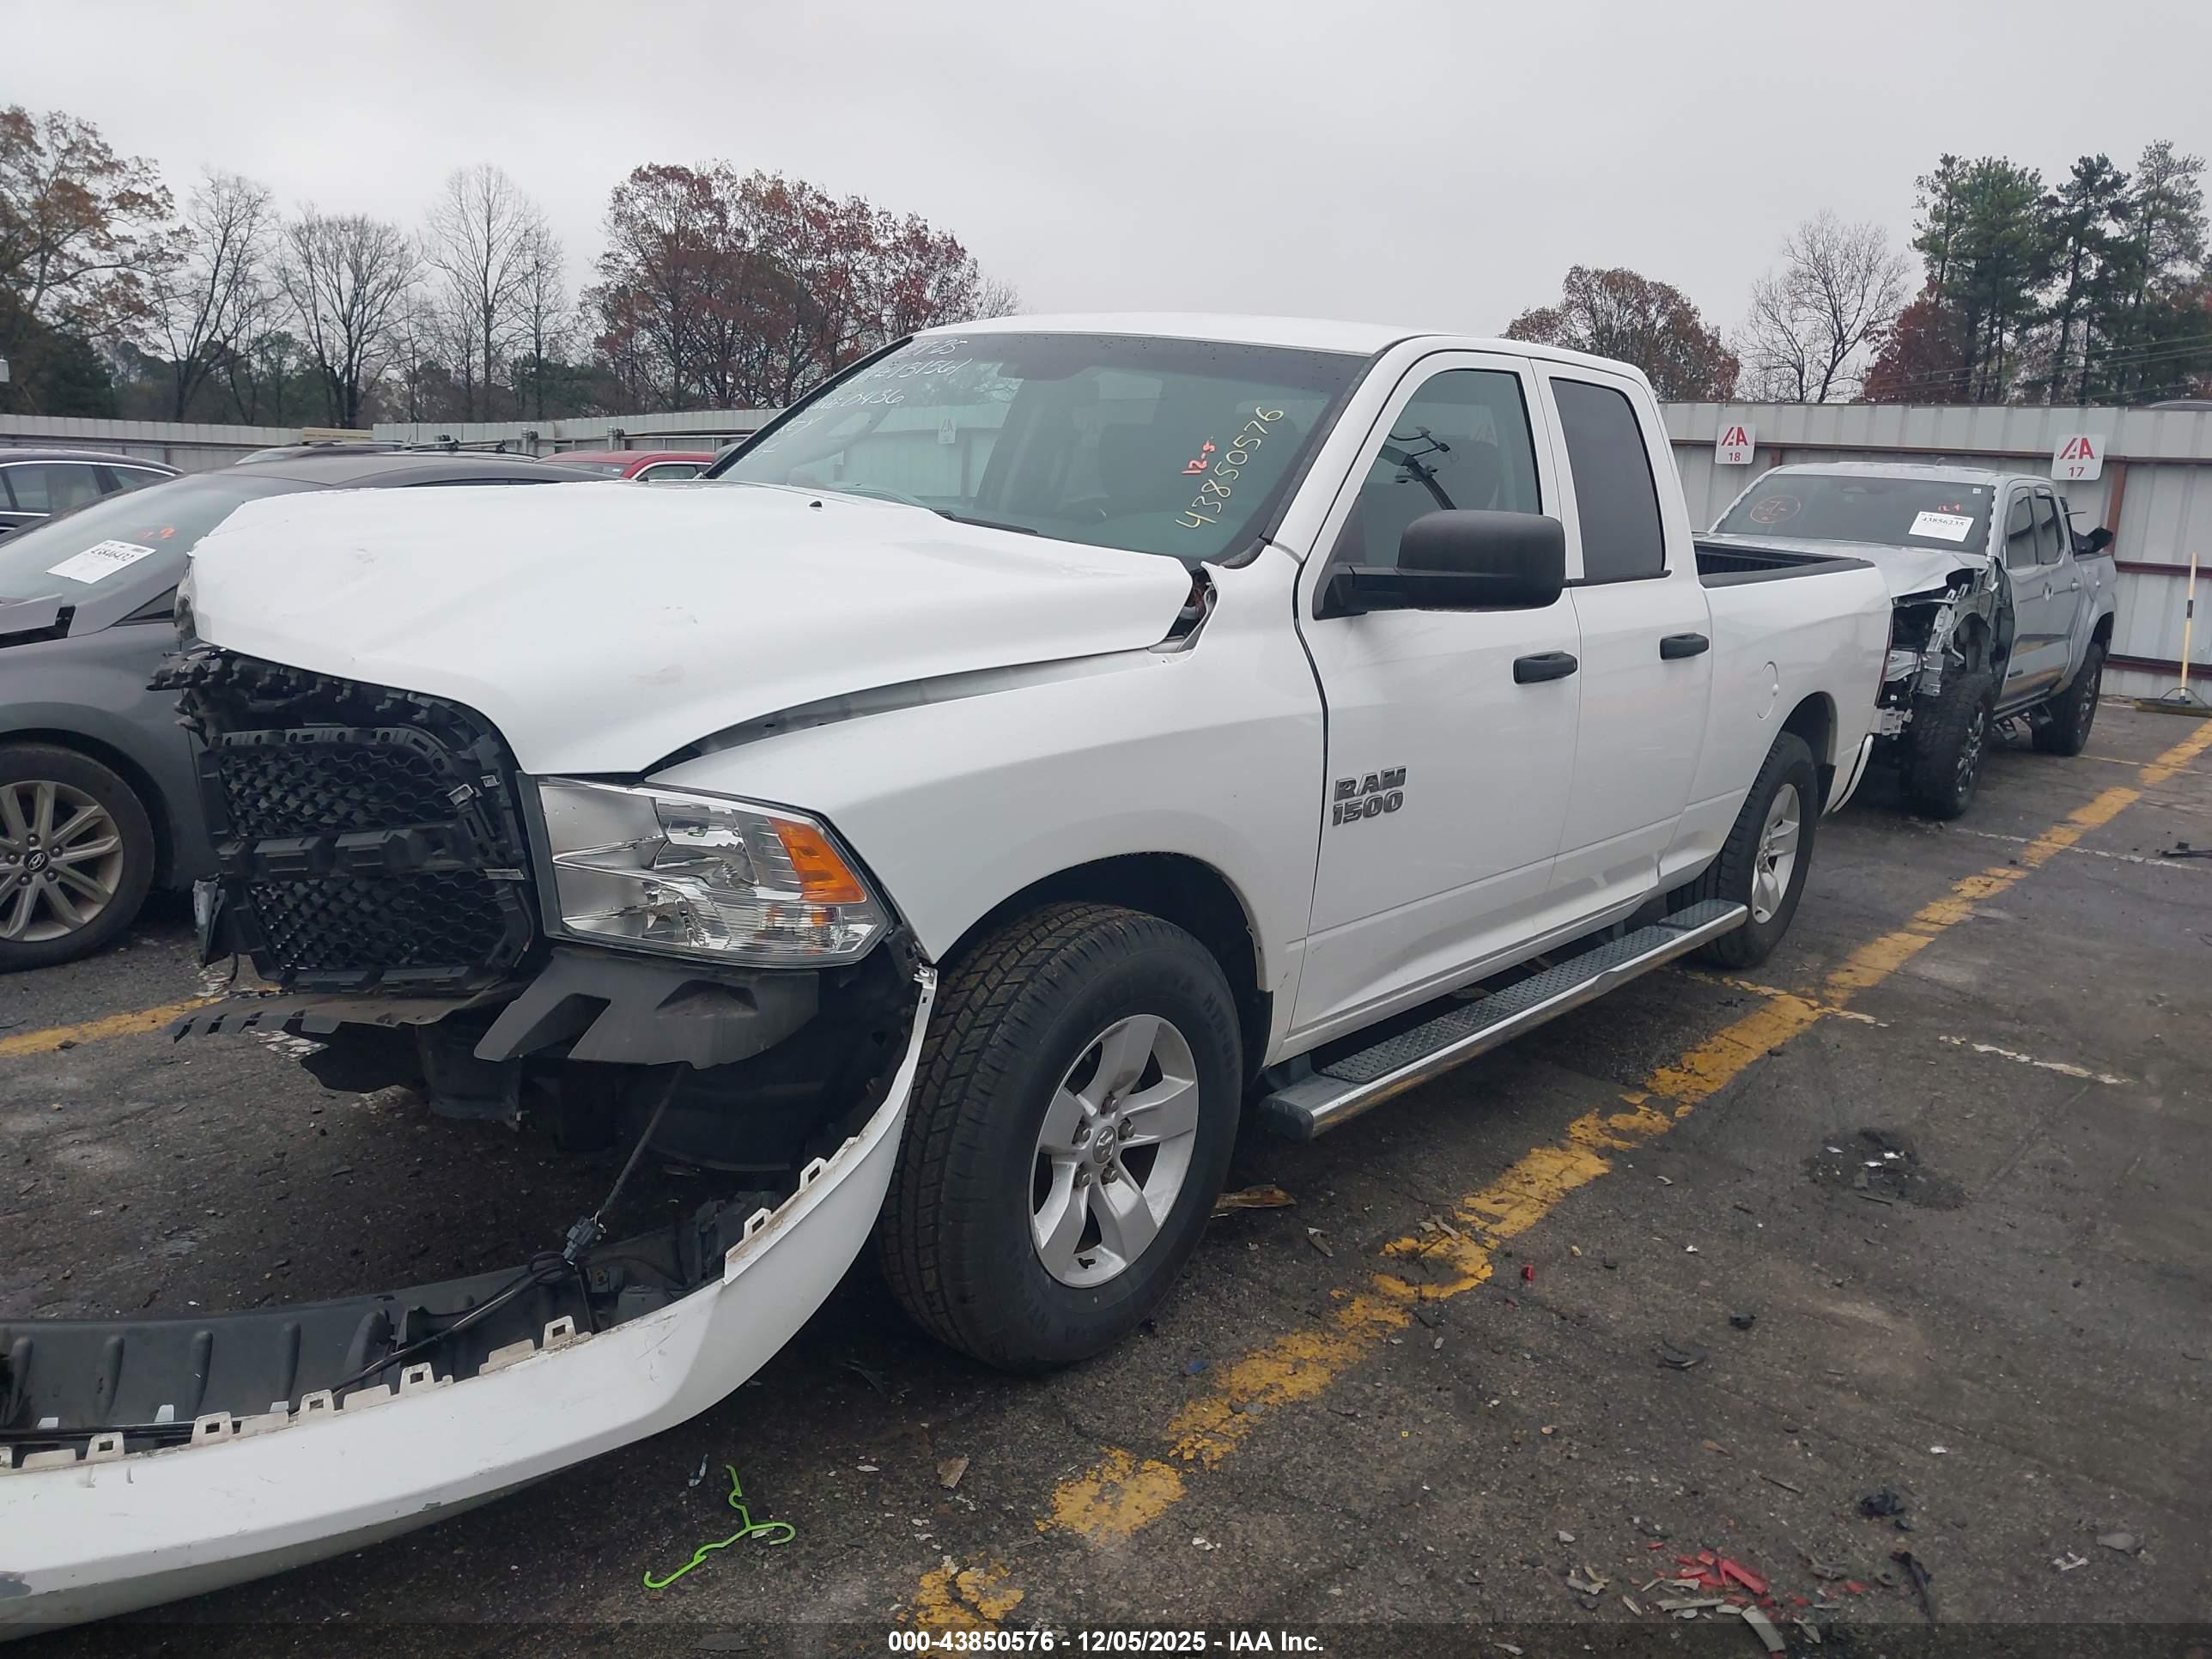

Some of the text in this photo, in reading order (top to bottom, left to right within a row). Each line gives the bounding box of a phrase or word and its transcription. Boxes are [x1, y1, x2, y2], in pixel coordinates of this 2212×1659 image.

[1175, 406, 1285, 529] 43850576
[1729, 452, 1741, 462] 18
[2069, 466, 2085, 477] 17
[1334, 765, 1407, 802] RAM
[1332, 790, 1404, 827] 1500
